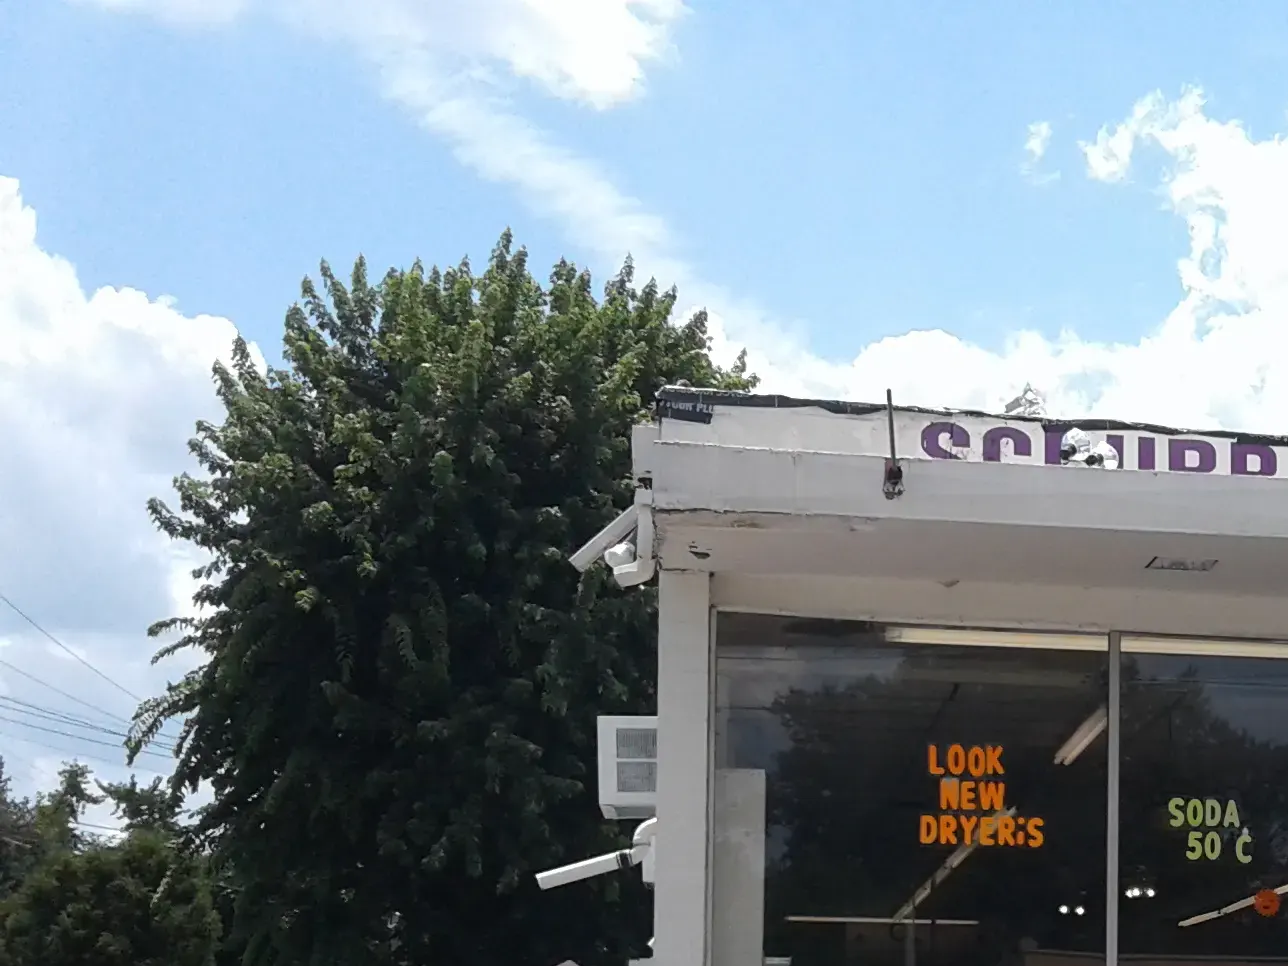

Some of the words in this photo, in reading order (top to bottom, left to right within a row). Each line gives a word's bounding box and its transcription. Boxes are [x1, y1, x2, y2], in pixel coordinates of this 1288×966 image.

[928, 744, 1005, 777] LOOK
[939, 777, 1006, 810] NEW
[1167, 797, 1240, 828] SODA
[1185, 831, 1222, 860] 50
